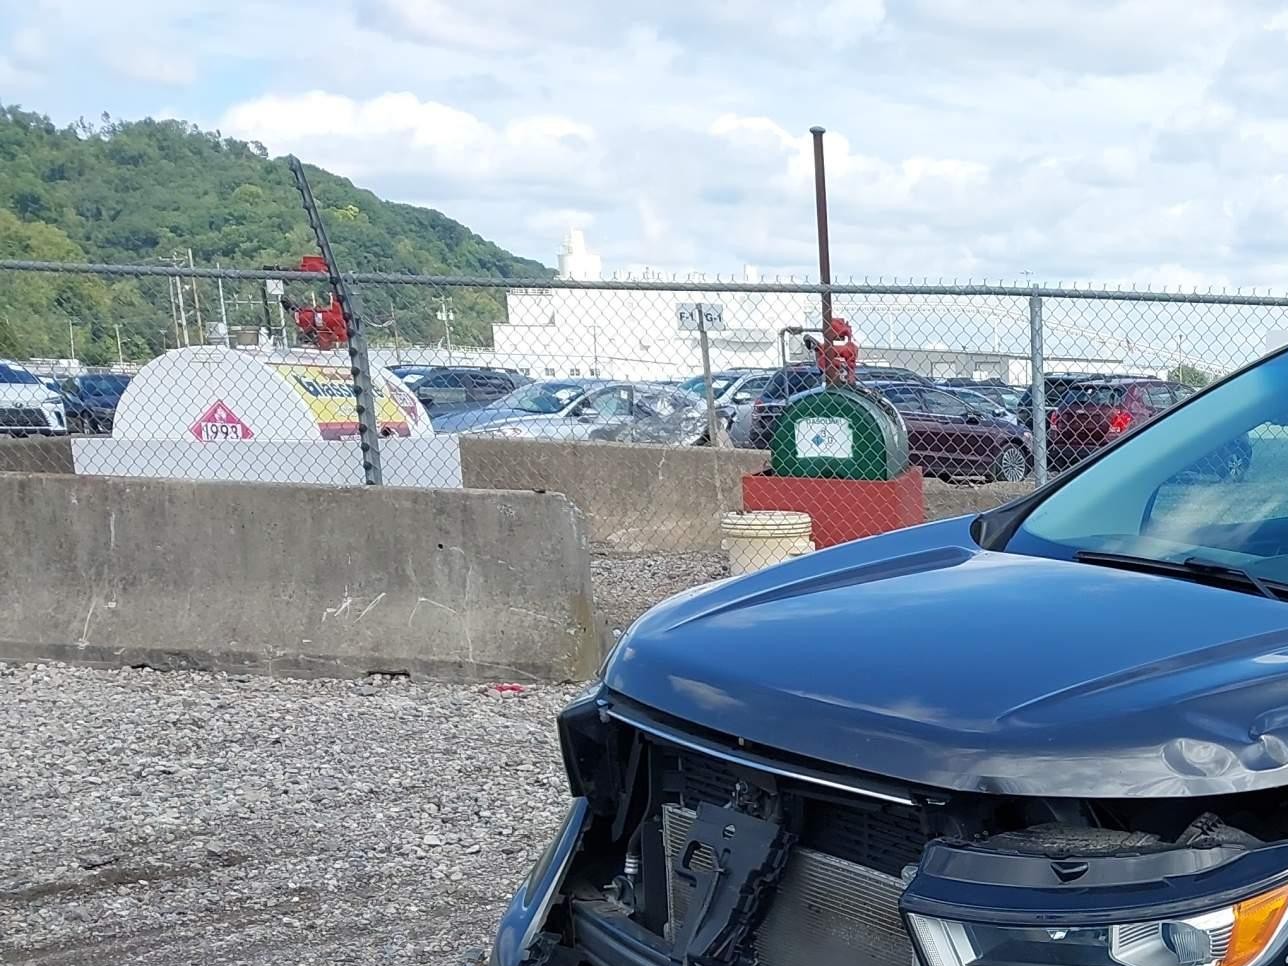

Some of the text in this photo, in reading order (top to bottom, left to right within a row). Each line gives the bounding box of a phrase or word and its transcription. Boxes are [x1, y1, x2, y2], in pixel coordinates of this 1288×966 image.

[680, 312, 694, 321] F-1
[705, 313, 722, 322] G-1
[203, 424, 239, 440] 1993
